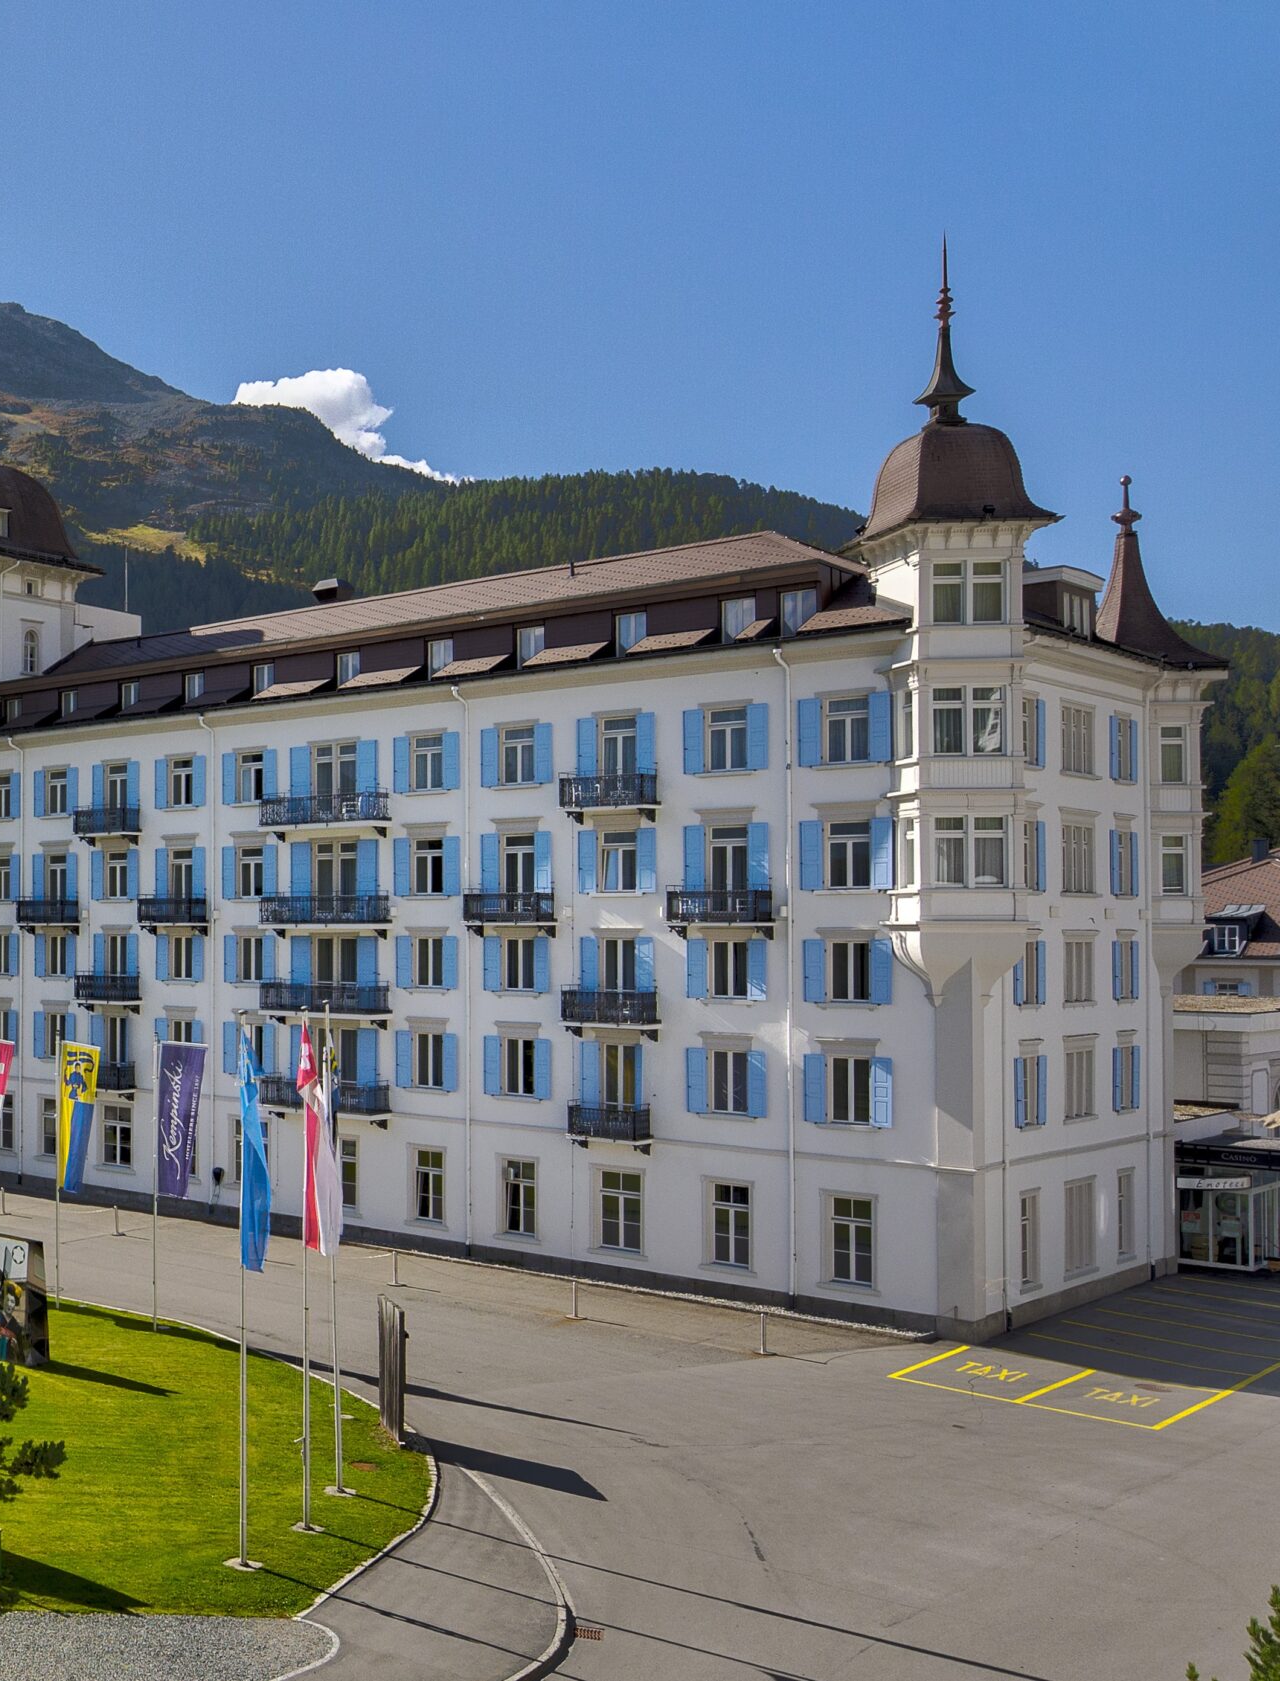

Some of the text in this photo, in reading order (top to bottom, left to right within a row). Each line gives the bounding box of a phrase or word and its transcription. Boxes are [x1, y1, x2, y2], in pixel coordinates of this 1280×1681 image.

[160, 1059, 185, 1180] Kempinski
[1220, 1152, 1257, 1163] CASINO
[955, 1361, 1029, 1383] TAXI
[1083, 1387, 1161, 1408] TAXI
